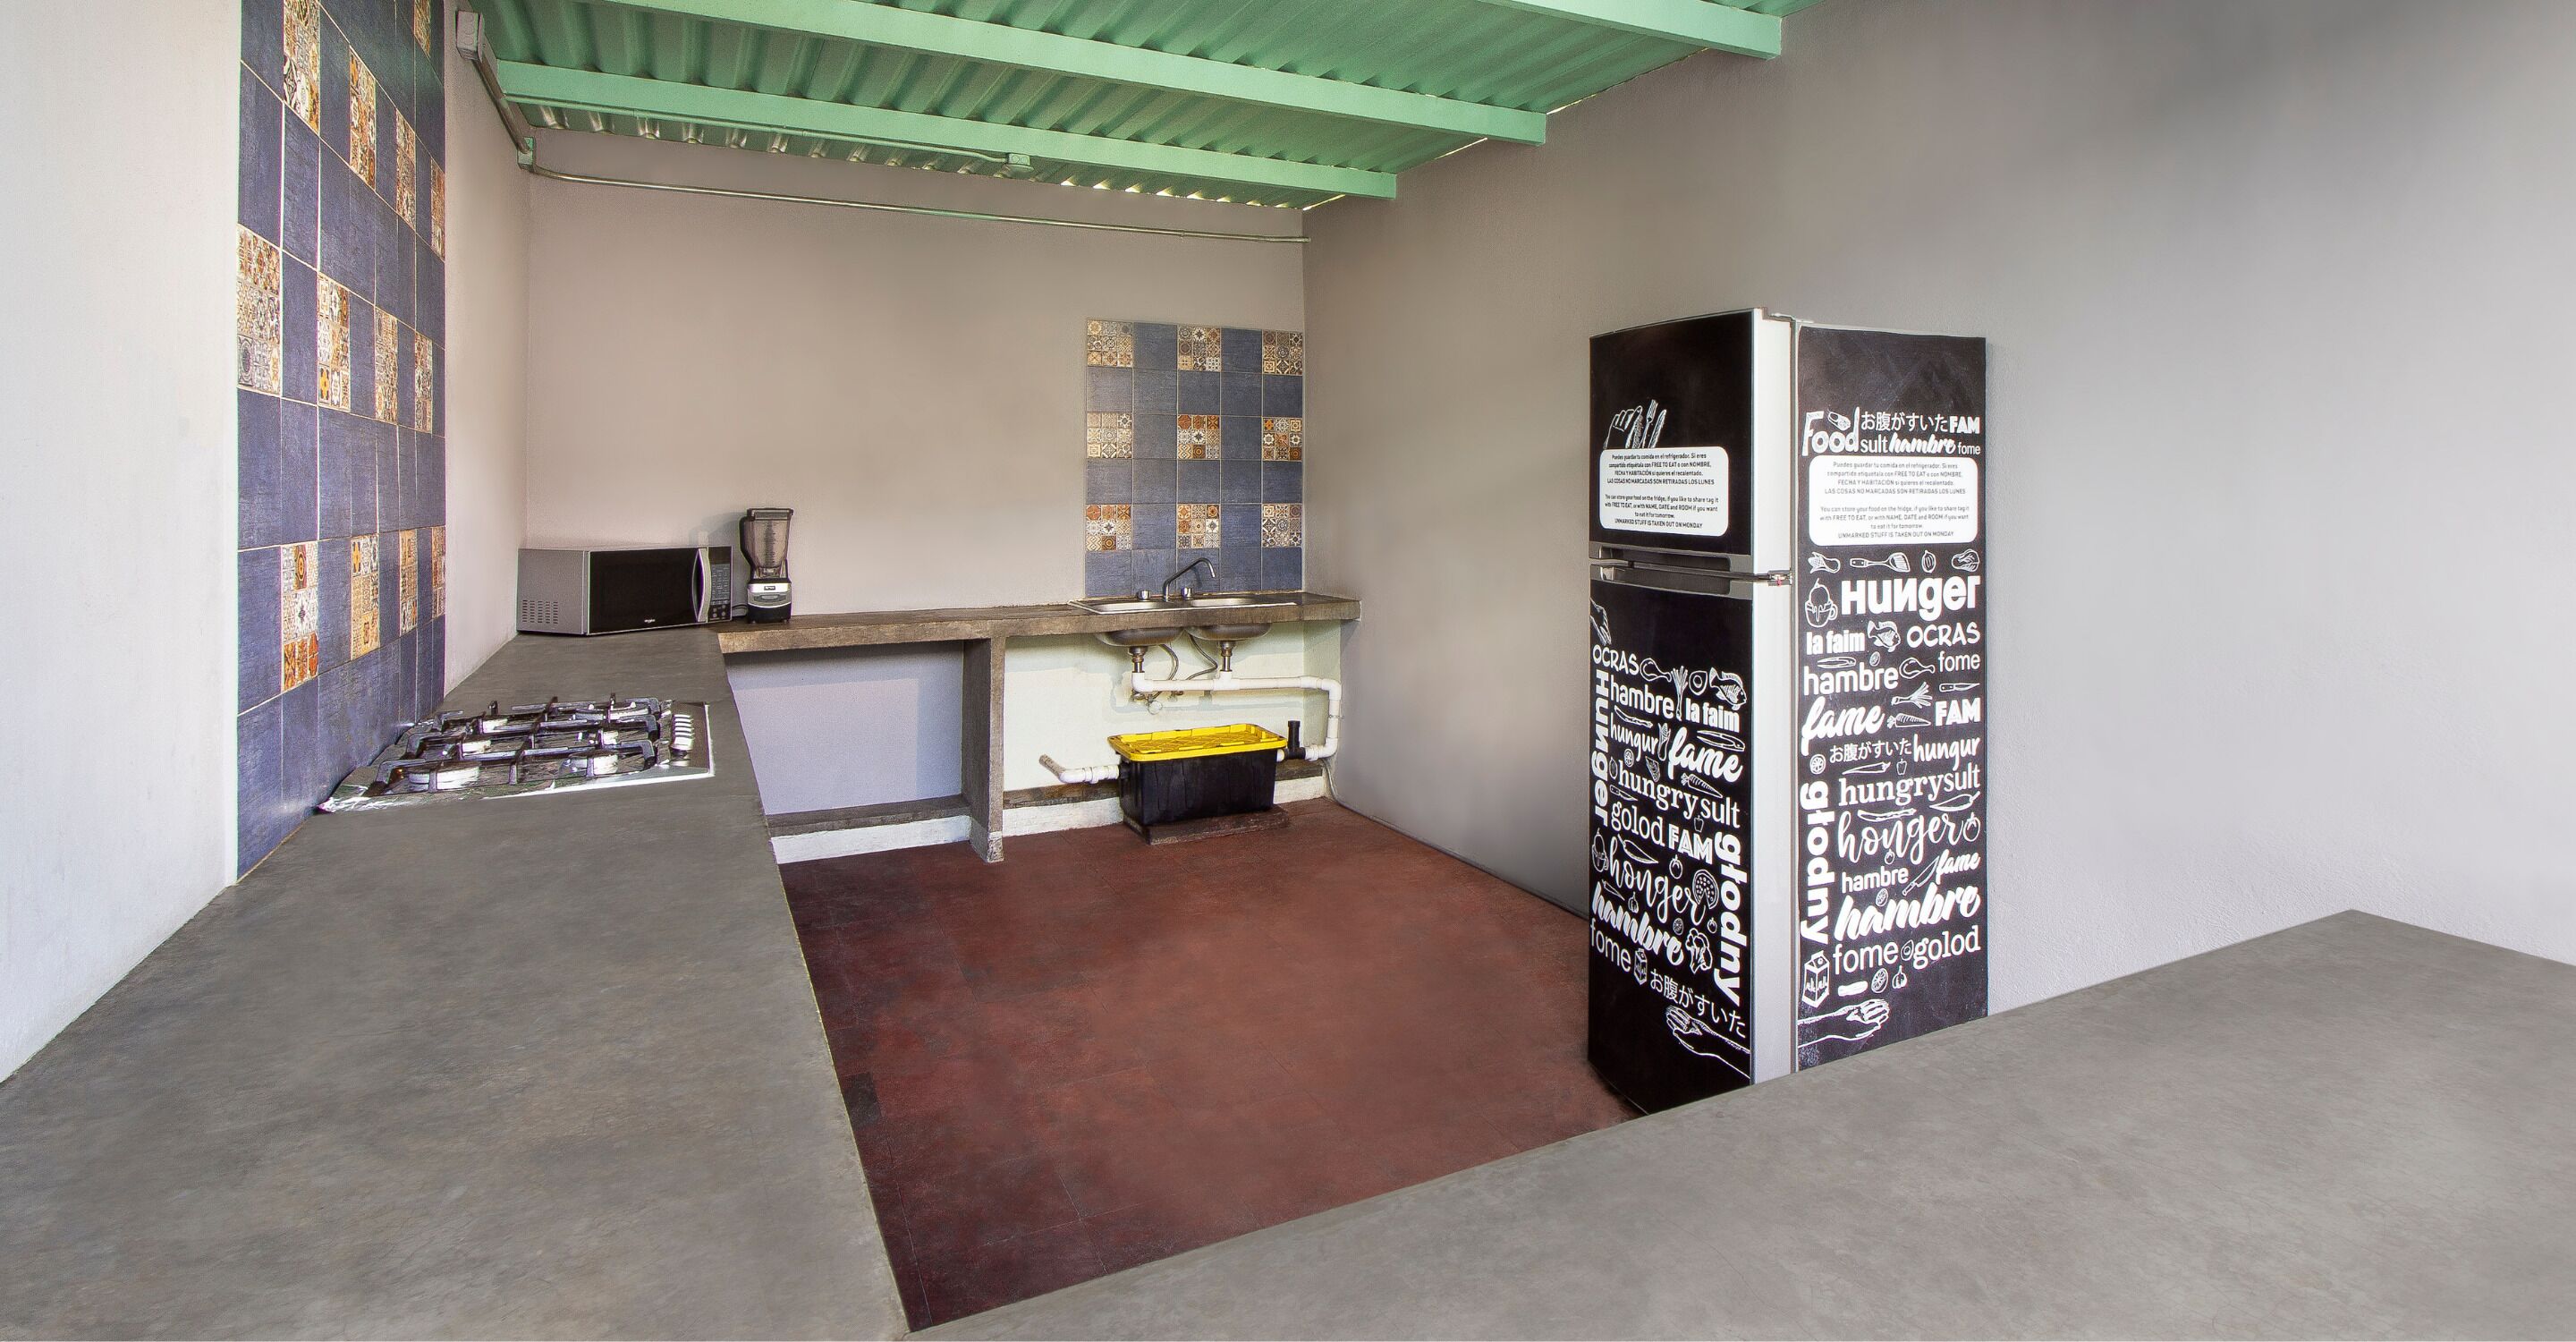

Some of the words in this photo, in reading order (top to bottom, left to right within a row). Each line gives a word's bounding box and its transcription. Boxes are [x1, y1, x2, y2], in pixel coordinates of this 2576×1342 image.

[1801, 406, 1860, 456] Food
[1860, 411, 1948, 432] お腹がすいた
[1949, 415, 1980, 435] FAM
[1860, 434, 1888, 454] sult
[1888, 432, 1957, 454] hambre
[1957, 442, 1981, 455] fome
[1806, 632, 1824, 655] la
[1826, 630, 1866, 654] faim
[1906, 622, 1981, 648] OCRAS
[1592, 644, 1640, 675] OCRAS
[1938, 650, 1981, 672] fome
[1611, 675, 1674, 719] hambre
[1803, 662, 1899, 696] hambre
[1685, 697, 1699, 724] la
[1702, 702, 1740, 733] faim
[1801, 696, 1885, 757] fame
[1935, 697, 1981, 726] FAM
[1610, 712, 1659, 761] hungur
[1668, 726, 1743, 783] fame
[1829, 737, 1912, 764] お腹がすいた
[1913, 734, 1981, 772] hungur
[1619, 760, 1698, 820] hungry
[1838, 772, 1950, 806] hungry
[1946, 762, 1981, 791] sult
[1611, 801, 1666, 847] golod
[1700, 796, 1741, 828] sult
[1668, 824, 1713, 865] FAM
[1838, 811, 1964, 865] honger
[1610, 836, 1707, 926] honger
[1842, 866, 1909, 894] hambre
[1936, 849, 1981, 885] fame
[1592, 881, 1685, 966] hambre
[1834, 883, 1981, 941] hambre
[1590, 923, 1632, 973] fome
[1833, 941, 1899, 975] fome
[1912, 925, 1981, 970] golod
[1650, 970, 1747, 1039] お腹がすいた
